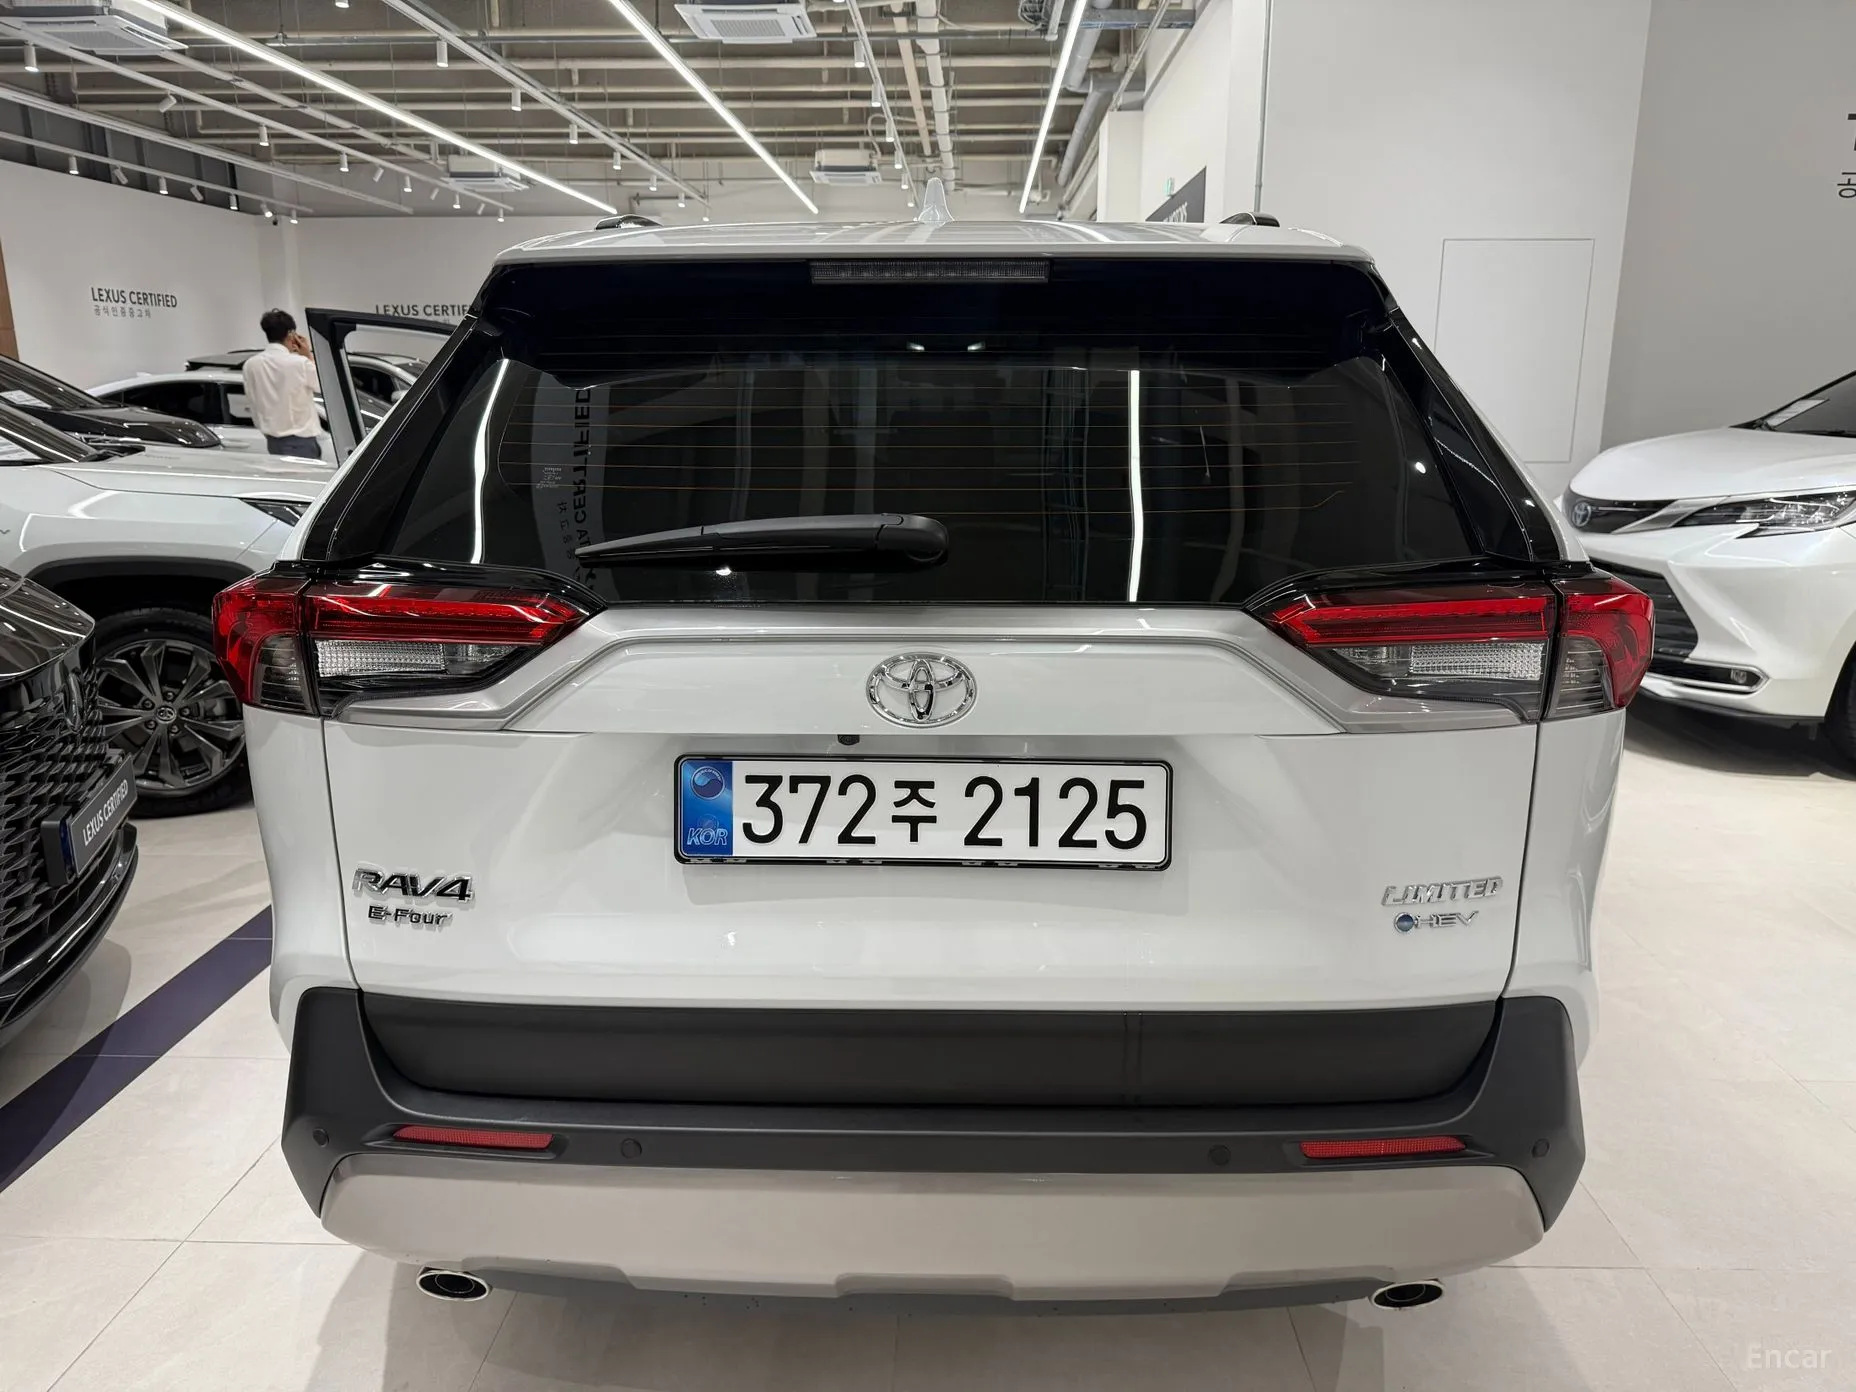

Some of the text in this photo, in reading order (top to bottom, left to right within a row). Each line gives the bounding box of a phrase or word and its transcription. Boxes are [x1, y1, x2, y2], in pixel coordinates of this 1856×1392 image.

[91, 286, 178, 308] LEXUS CERTIFIED
[423, 304, 471, 317] CERTIF
[82, 779, 129, 847] LEXUS CERTIFIED
[964, 775, 1147, 850] 2125
[686, 827, 728, 846] KOR
[352, 867, 473, 902] RAV4
[1381, 876, 1503, 906] LIMITED
[368, 905, 453, 925] E-Four
[1415, 910, 1479, 929] HEV
